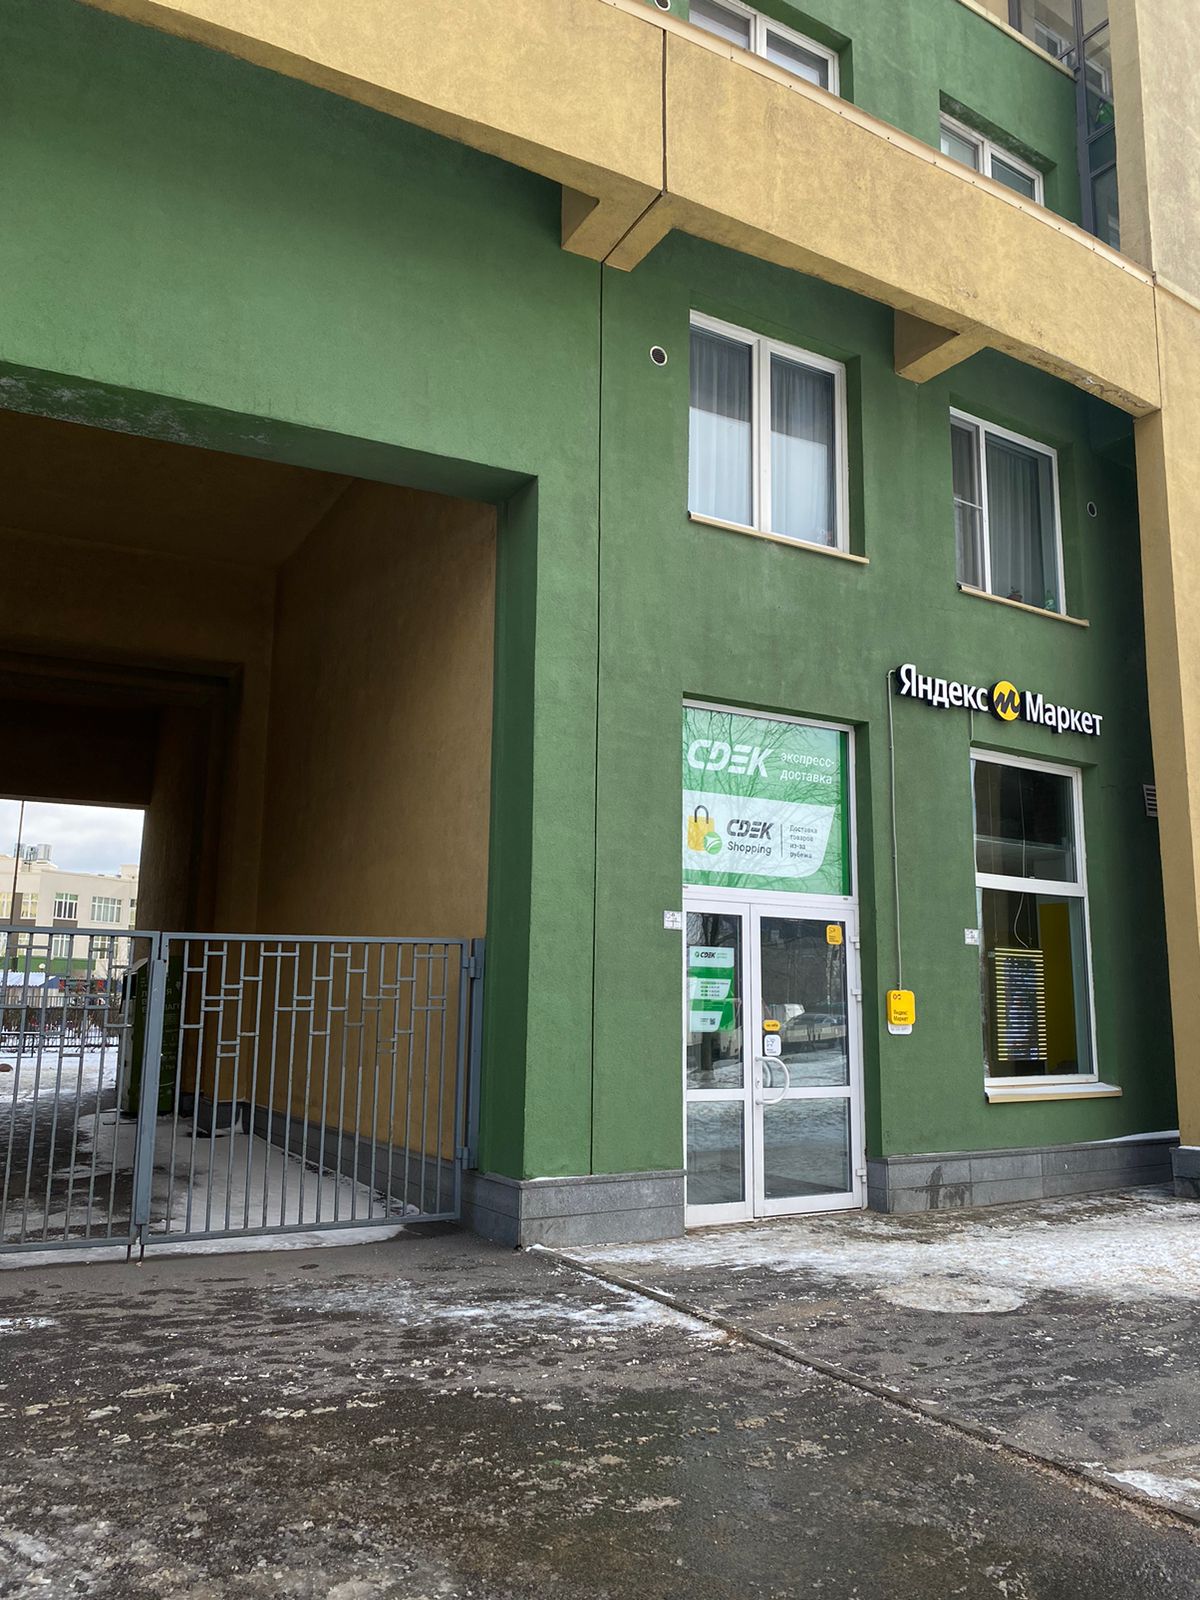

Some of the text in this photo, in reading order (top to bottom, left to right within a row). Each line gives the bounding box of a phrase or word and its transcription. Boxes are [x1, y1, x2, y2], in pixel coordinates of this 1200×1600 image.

[900, 663, 989, 711] Яндекс
[1025, 690, 1103, 736] Маркет
[780, 769, 832, 784] доставка
[728, 841, 772, 856] Shopping
